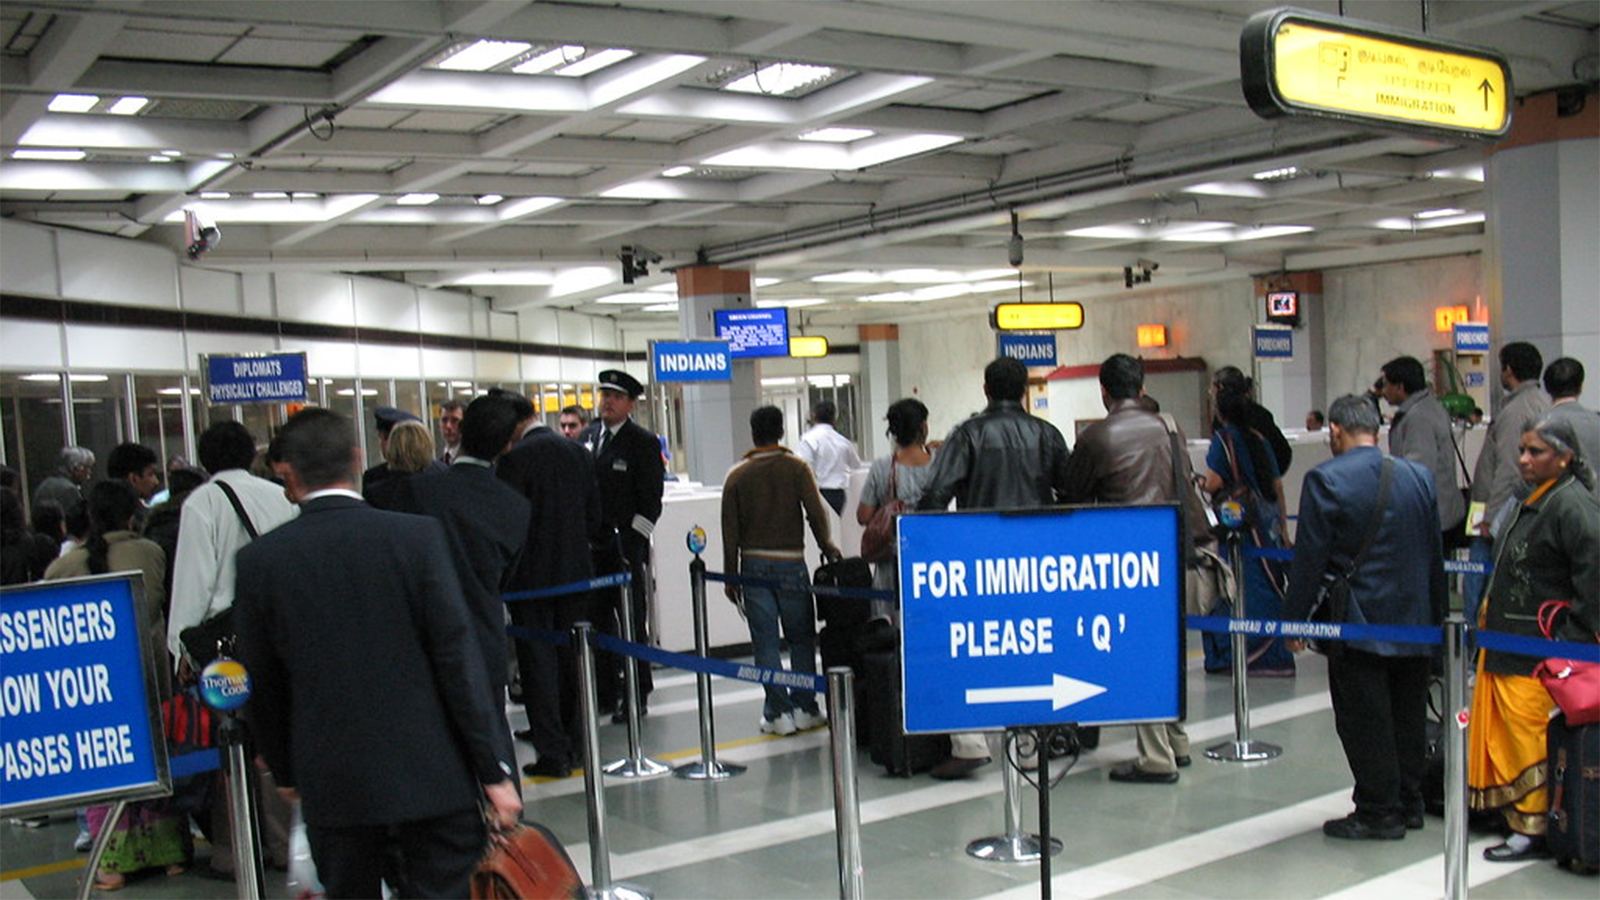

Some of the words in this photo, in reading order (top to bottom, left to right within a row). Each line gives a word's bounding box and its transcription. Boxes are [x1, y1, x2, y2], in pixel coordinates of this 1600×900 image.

[1375, 92, 1456, 115] IMMIGRATION
[1003, 343, 1054, 360] INDIANS
[233, 360, 282, 378] DIPLOMATS
[659, 352, 727, 373] INDIANS
[210, 382, 255, 400] PHYSICALLY
[255, 380, 304, 398] CHALLENGED
[911, 560, 968, 599] FOR
[975, 550, 1160, 596] IMMIGRATION
[0, 599, 116, 655] SSENGERS
[1228, 619, 1262, 633] BUREAU
[1264, 620, 1277, 634] OF
[1281, 621, 1341, 638] IMMIGRATION
[949, 617, 1054, 659] PLEASE
[0, 672, 41, 718] OW
[44, 663, 113, 710] YOUR
[204, 676, 248, 691] Thomas
[220, 686, 249, 698] Cook
[75, 723, 135, 771] HERE
